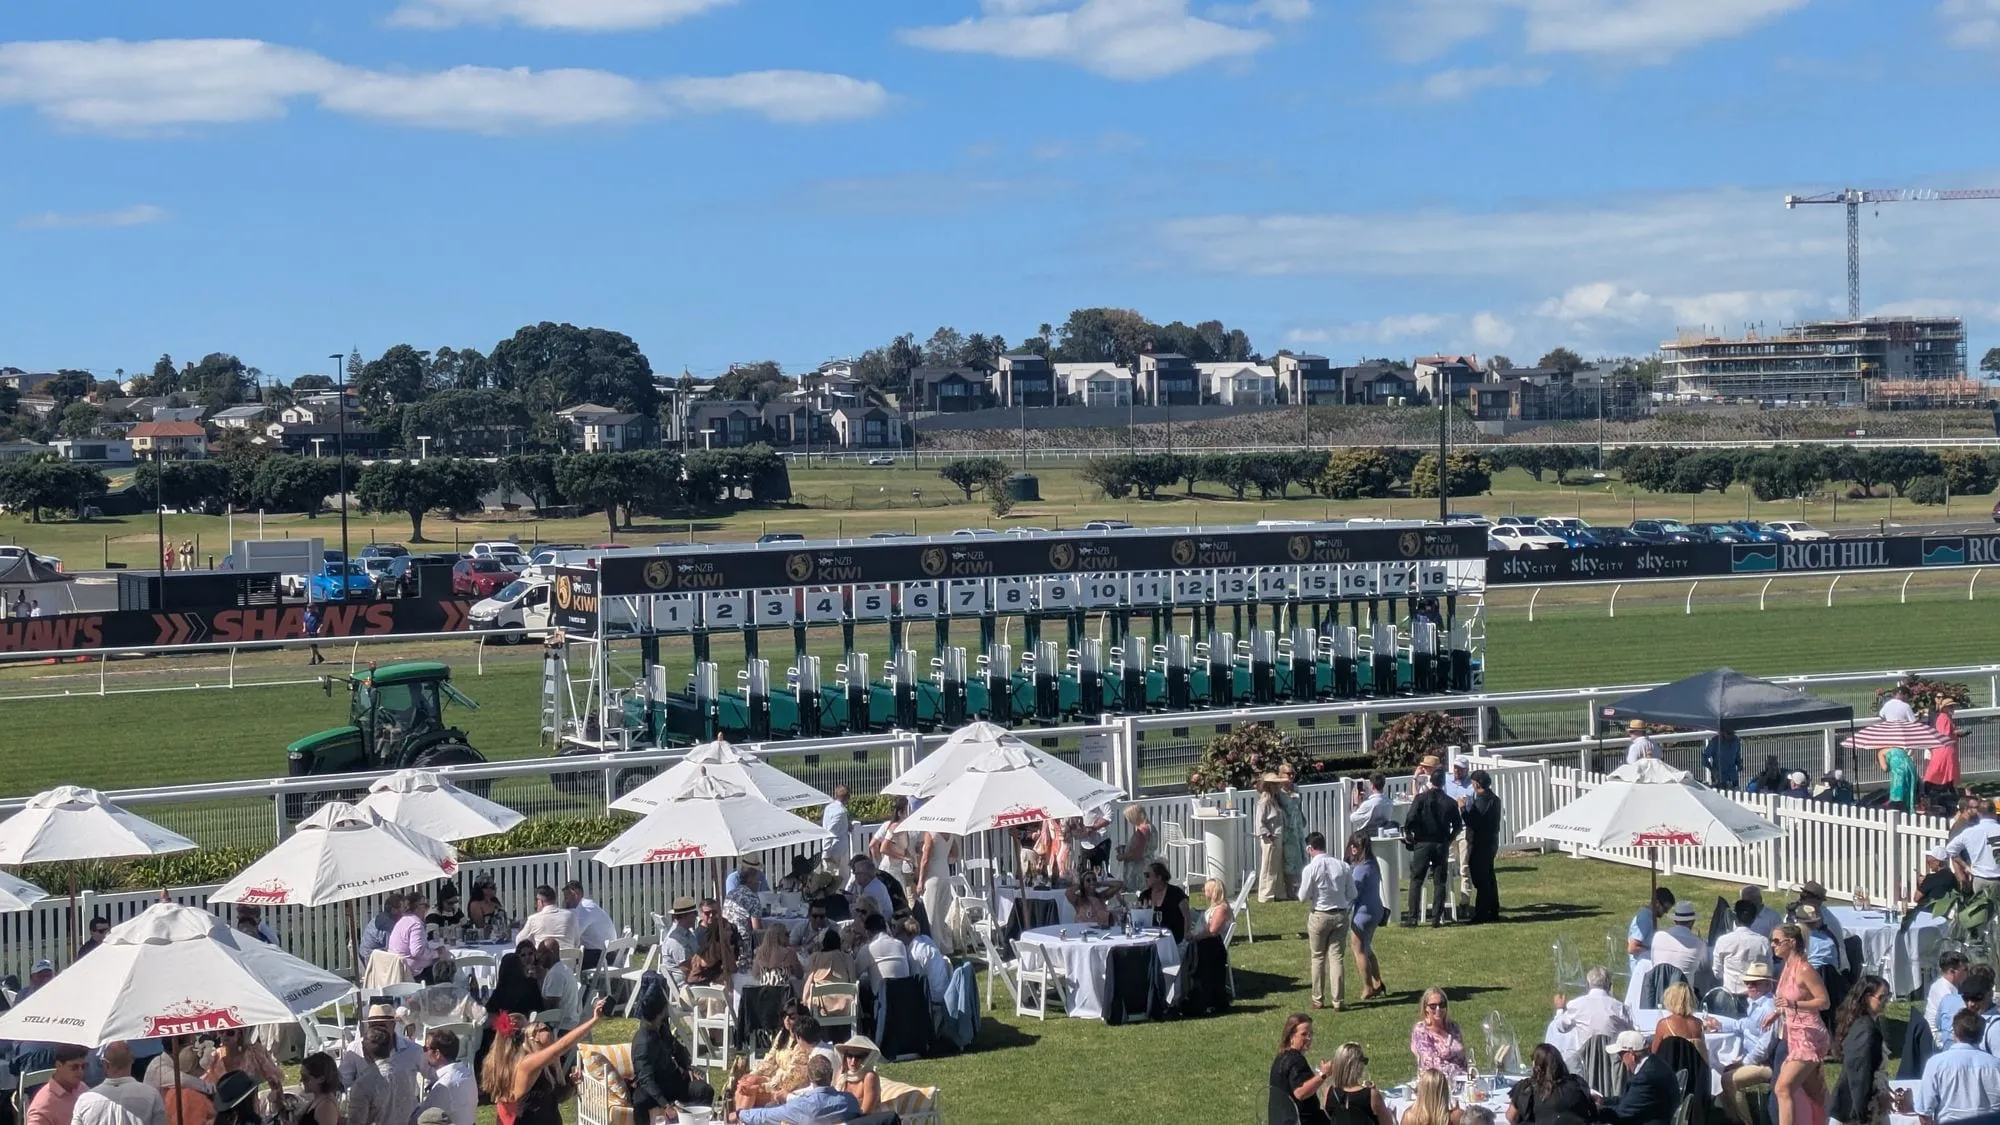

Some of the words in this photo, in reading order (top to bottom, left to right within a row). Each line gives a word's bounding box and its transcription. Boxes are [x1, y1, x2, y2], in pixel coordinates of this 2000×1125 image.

[967, 550, 984, 560] NZB
[1314, 548, 1350, 561] KIWI
[1424, 544, 1458, 556] KIWI
[1782, 543, 1836, 569] RICH
[1840, 541, 1890, 567] HILL
[834, 556, 852, 565] NZB
[1078, 556, 1118, 569] KIWI
[1198, 550, 1236, 564] KIWI
[694, 563, 714, 572] NZB
[818, 566, 862, 581] KIWI
[952, 561, 993, 575] KIWI
[677, 573, 724, 588] KIWI
[1262, 578, 1286, 591] 14
[1304, 576, 1326, 590] 15
[1344, 575, 1366, 588] 16
[1383, 574, 1406, 587] 17
[1422, 572, 1444, 584] 18
[582, 584, 592, 594] NZB
[1052, 586, 1066, 600] 9
[1091, 584, 1116, 598] 10
[1137, 583, 1158, 596] 11
[1178, 582, 1202, 595] 12
[1220, 580, 1244, 593] 13
[914, 594, 928, 607] 6
[960, 592, 974, 605] 7
[1007, 589, 1020, 602] 8
[573, 595, 597, 613] KIWI
[768, 602, 782, 615] 3
[816, 598, 832, 612] 4
[866, 596, 881, 610] 5
[669, 607, 678, 621] 1
[717, 604, 732, 618] 2
[212, 604, 394, 642] SHAW'S
[1000, 814, 1043, 826] STELLA
[1642, 838, 1692, 846] STELLA
[336, 880, 368, 890] STELLA
[378, 871, 409, 883] ARTOIS
[22, 1016, 50, 1024] STELLA
[58, 1018, 86, 1026] ARTOIS
[158, 1018, 231, 1035] STELLA
